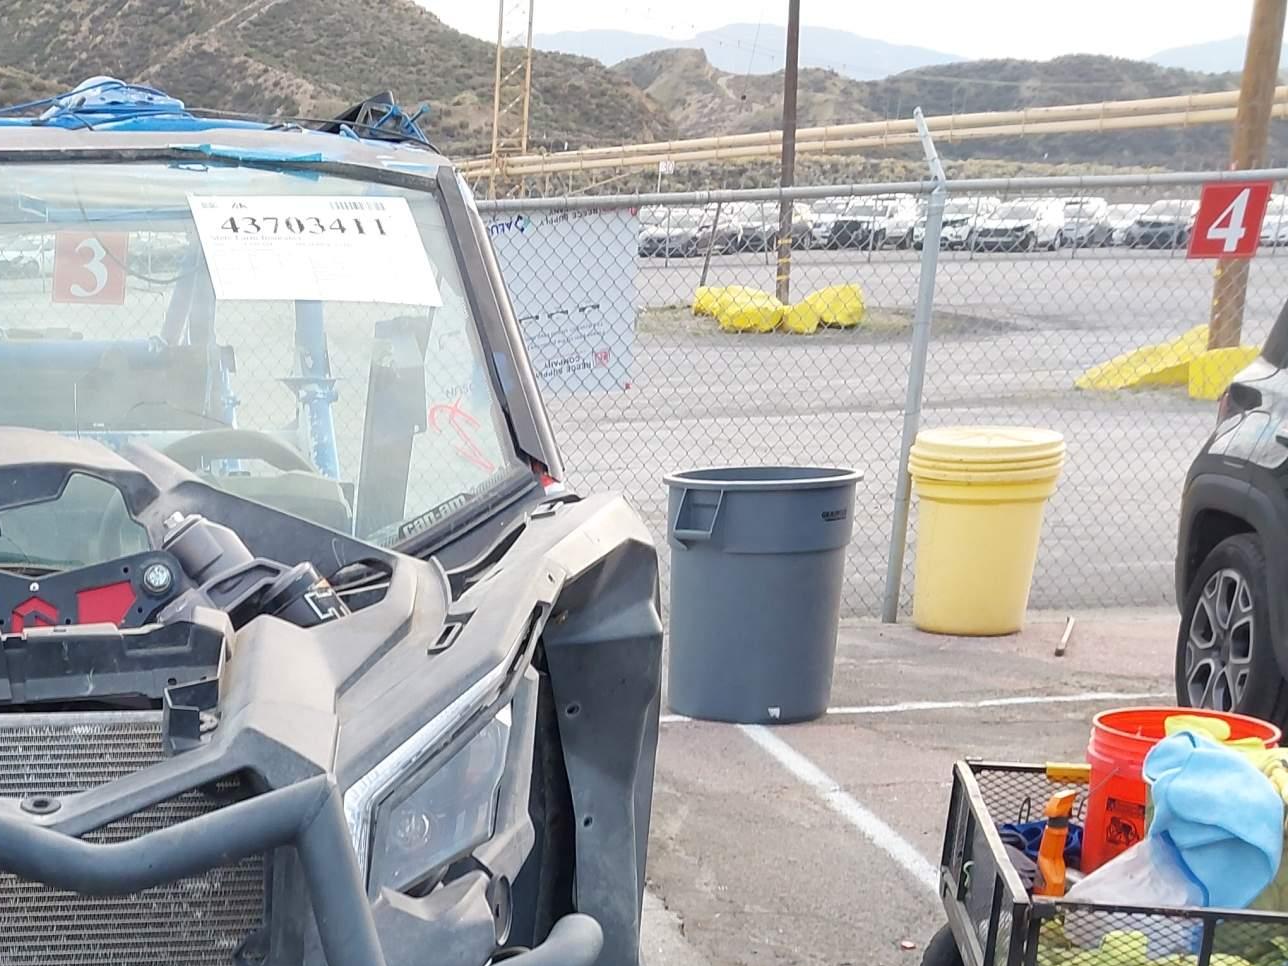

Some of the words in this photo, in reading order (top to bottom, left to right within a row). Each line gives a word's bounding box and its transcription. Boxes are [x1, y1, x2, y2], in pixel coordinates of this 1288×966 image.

[220, 215, 389, 236] 43703411
[1206, 187, 1251, 252] 4
[70, 238, 108, 297] 3
